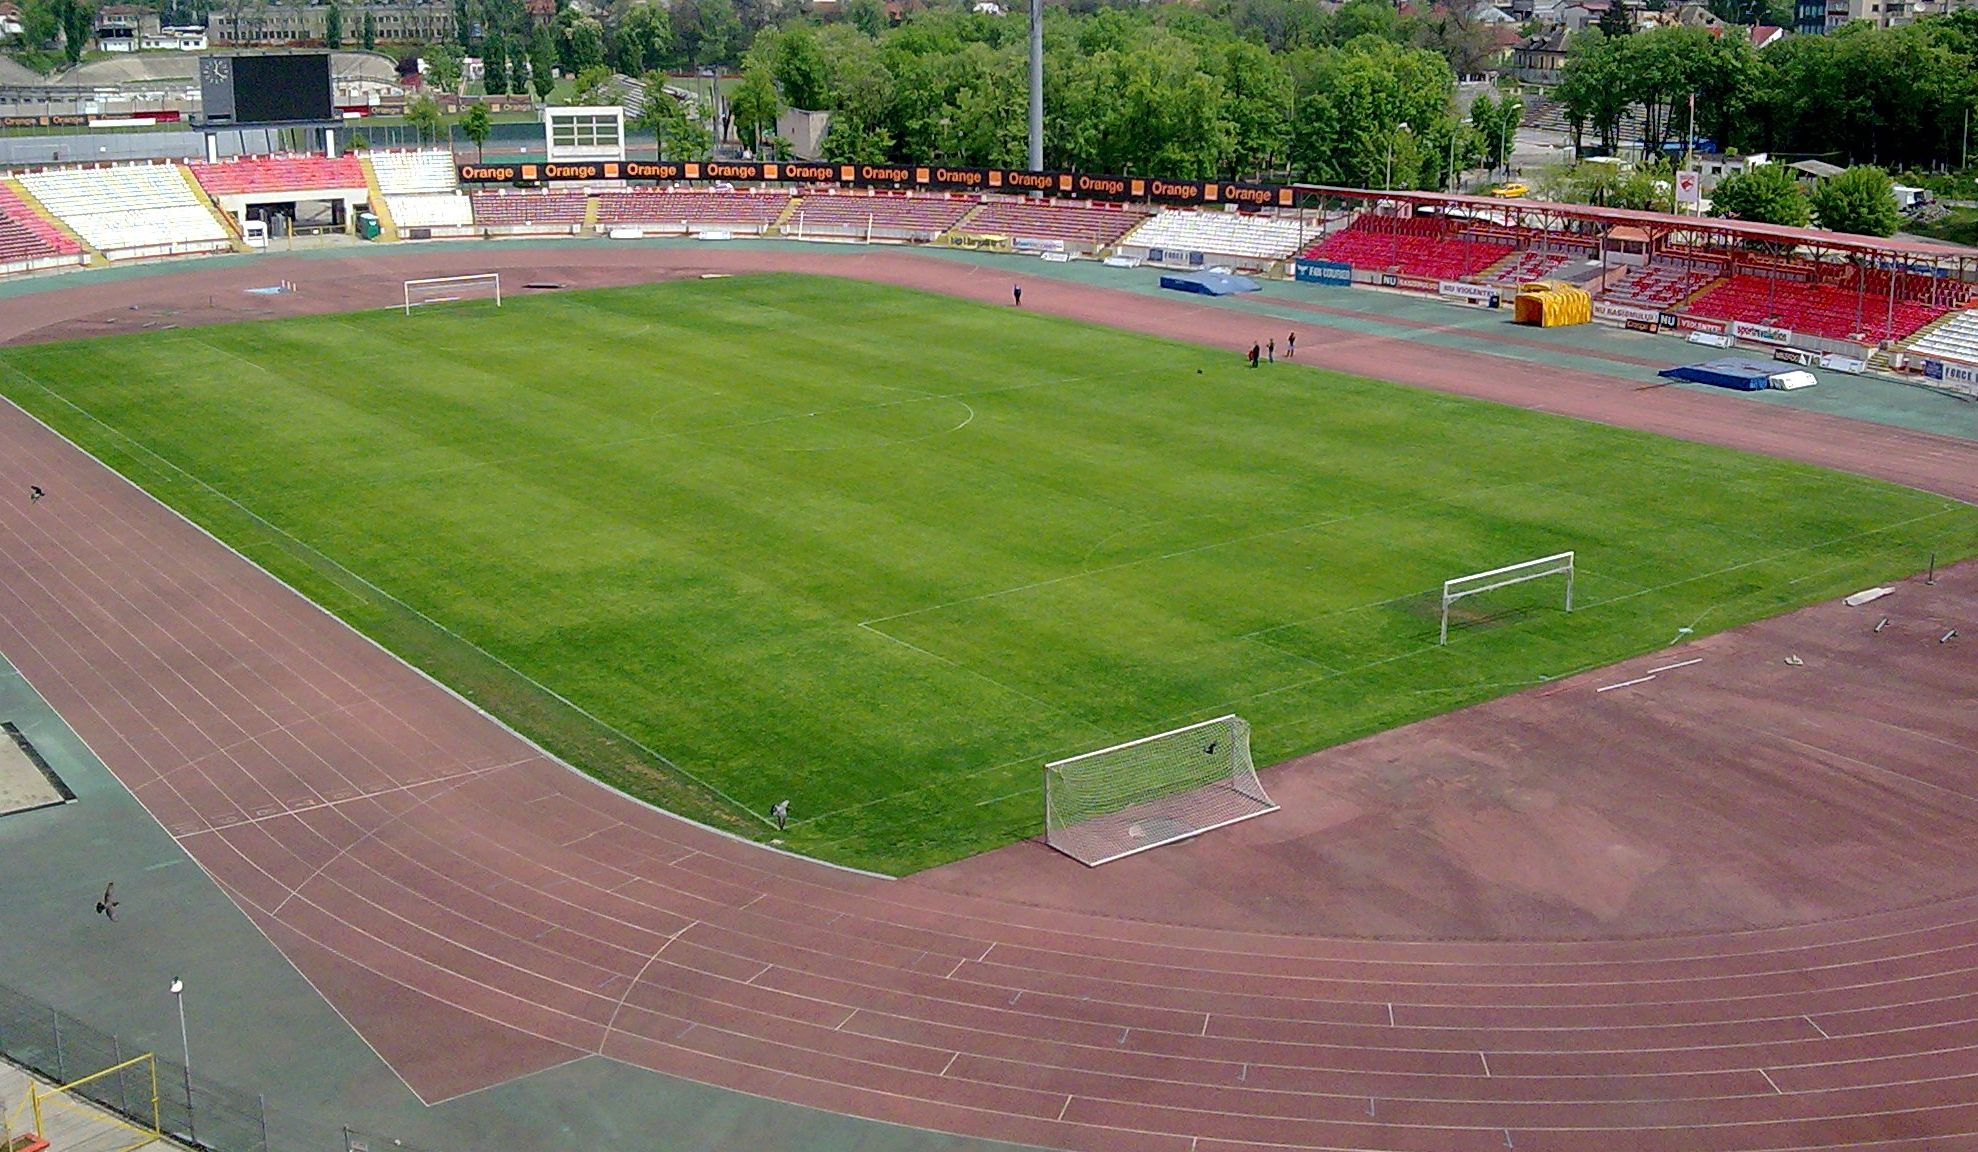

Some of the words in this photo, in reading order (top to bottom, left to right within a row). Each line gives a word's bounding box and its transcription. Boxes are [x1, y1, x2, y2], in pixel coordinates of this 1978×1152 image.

[463, 167, 514, 180] Orange
[545, 165, 596, 178] Orange
[627, 164, 677, 178] Orange
[707, 164, 756, 178] Orange
[786, 165, 833, 179] Orange
[863, 166, 909, 181] Orange
[936, 169, 982, 185] Orange
[1009, 172, 1053, 188] Orange
[1079, 176, 1124, 194] Orange
[1152, 181, 1198, 198] Orange
[1225, 186, 1271, 203] Orange
[1383, 275, 1396, 286] NU
[1595, 306, 1606, 314] NU
[1660, 314, 1676, 327] NU
[1945, 367, 1972, 380] FORCE
